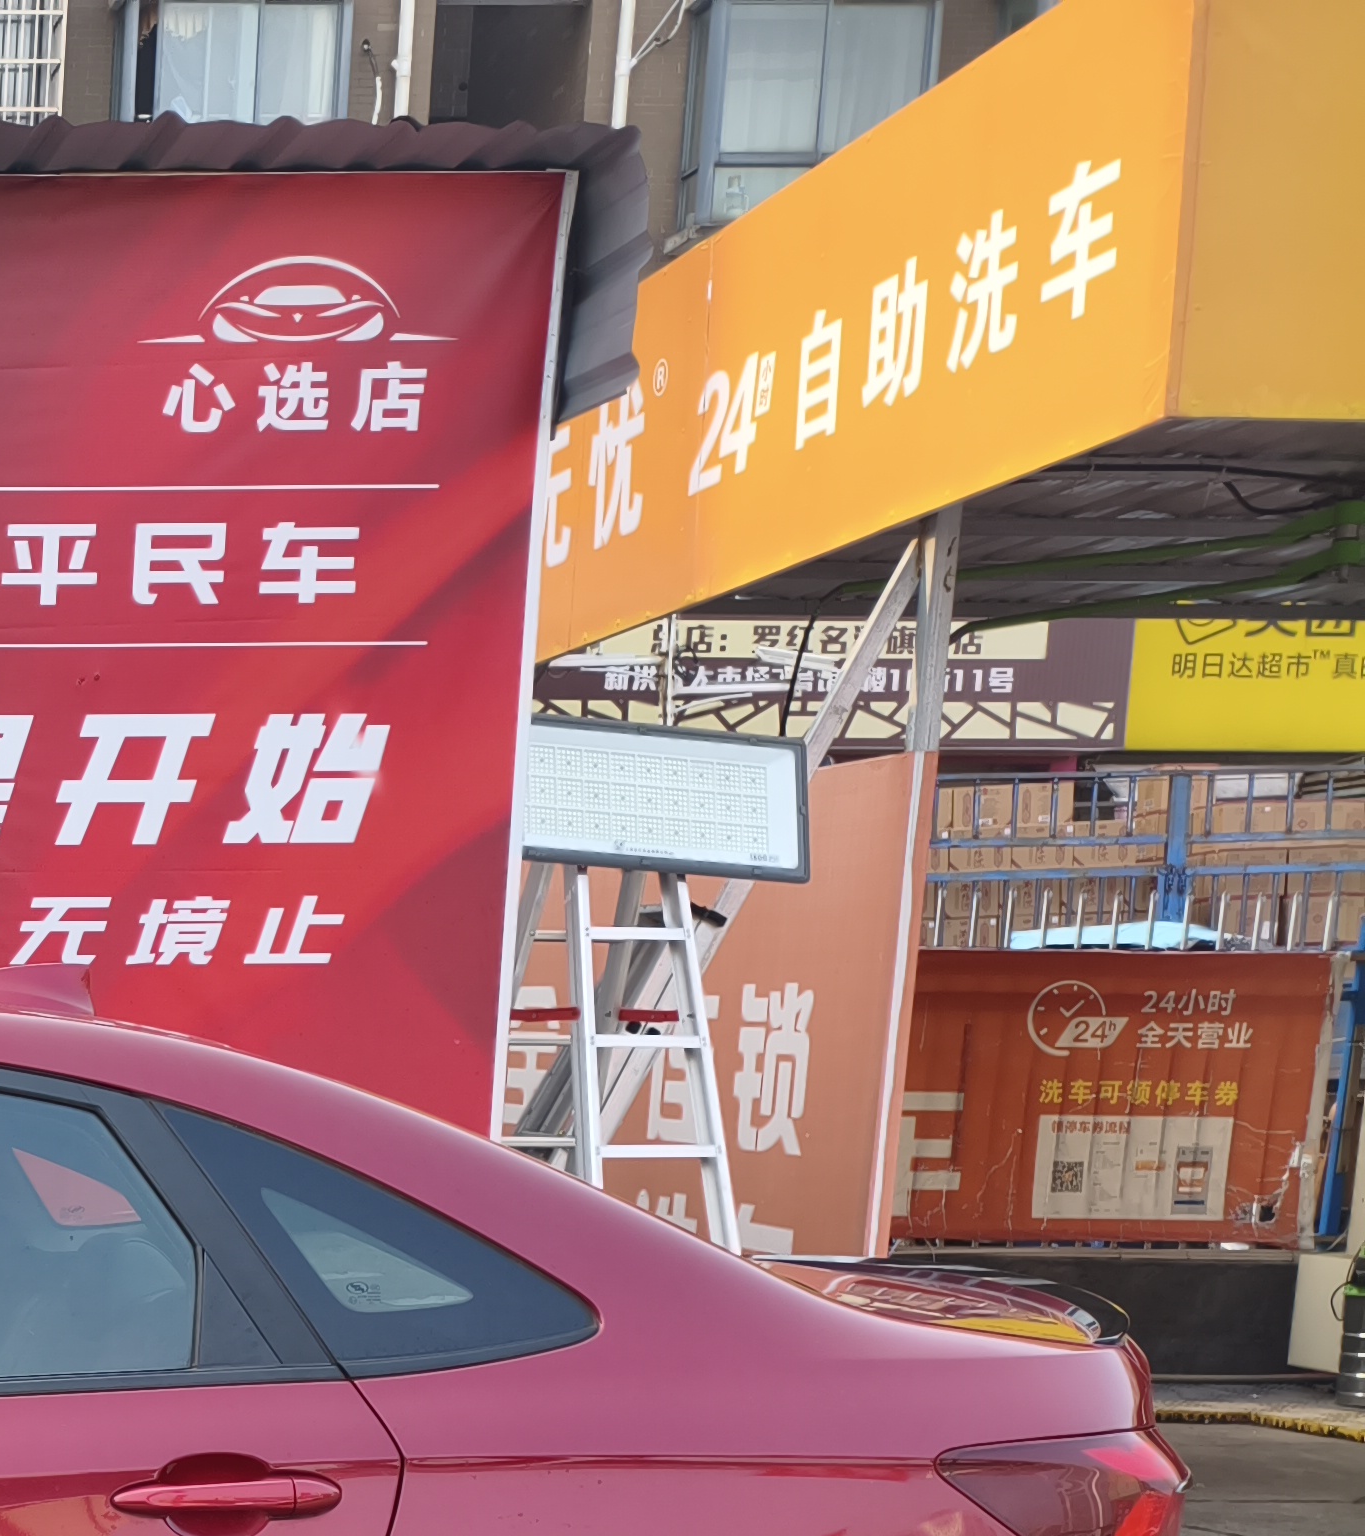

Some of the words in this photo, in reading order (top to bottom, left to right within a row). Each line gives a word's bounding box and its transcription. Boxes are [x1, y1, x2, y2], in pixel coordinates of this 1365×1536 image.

[162, 360, 428, 434] 心选店
[1140, 988, 1237, 1016] 24小时
[1136, 1021, 1253, 1049] 全天营业
[1039, 1079, 1239, 1107] 洗车可领停车券
